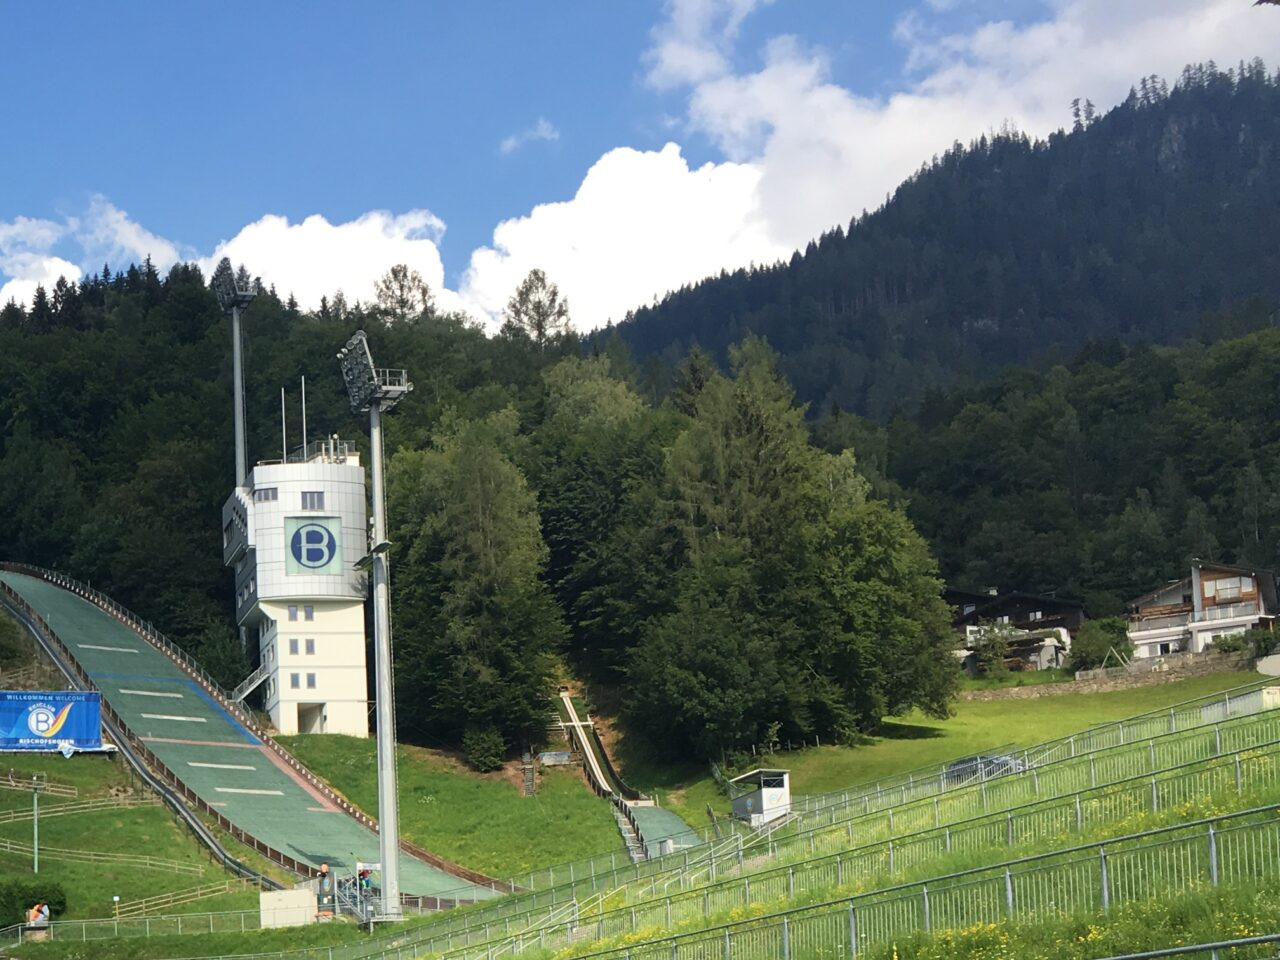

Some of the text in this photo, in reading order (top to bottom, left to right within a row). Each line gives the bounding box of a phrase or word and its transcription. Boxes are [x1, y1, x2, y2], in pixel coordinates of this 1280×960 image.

[299, 523, 330, 568] B
[28, 702, 56, 713] SKICLUB
[35, 711, 50, 732] B
